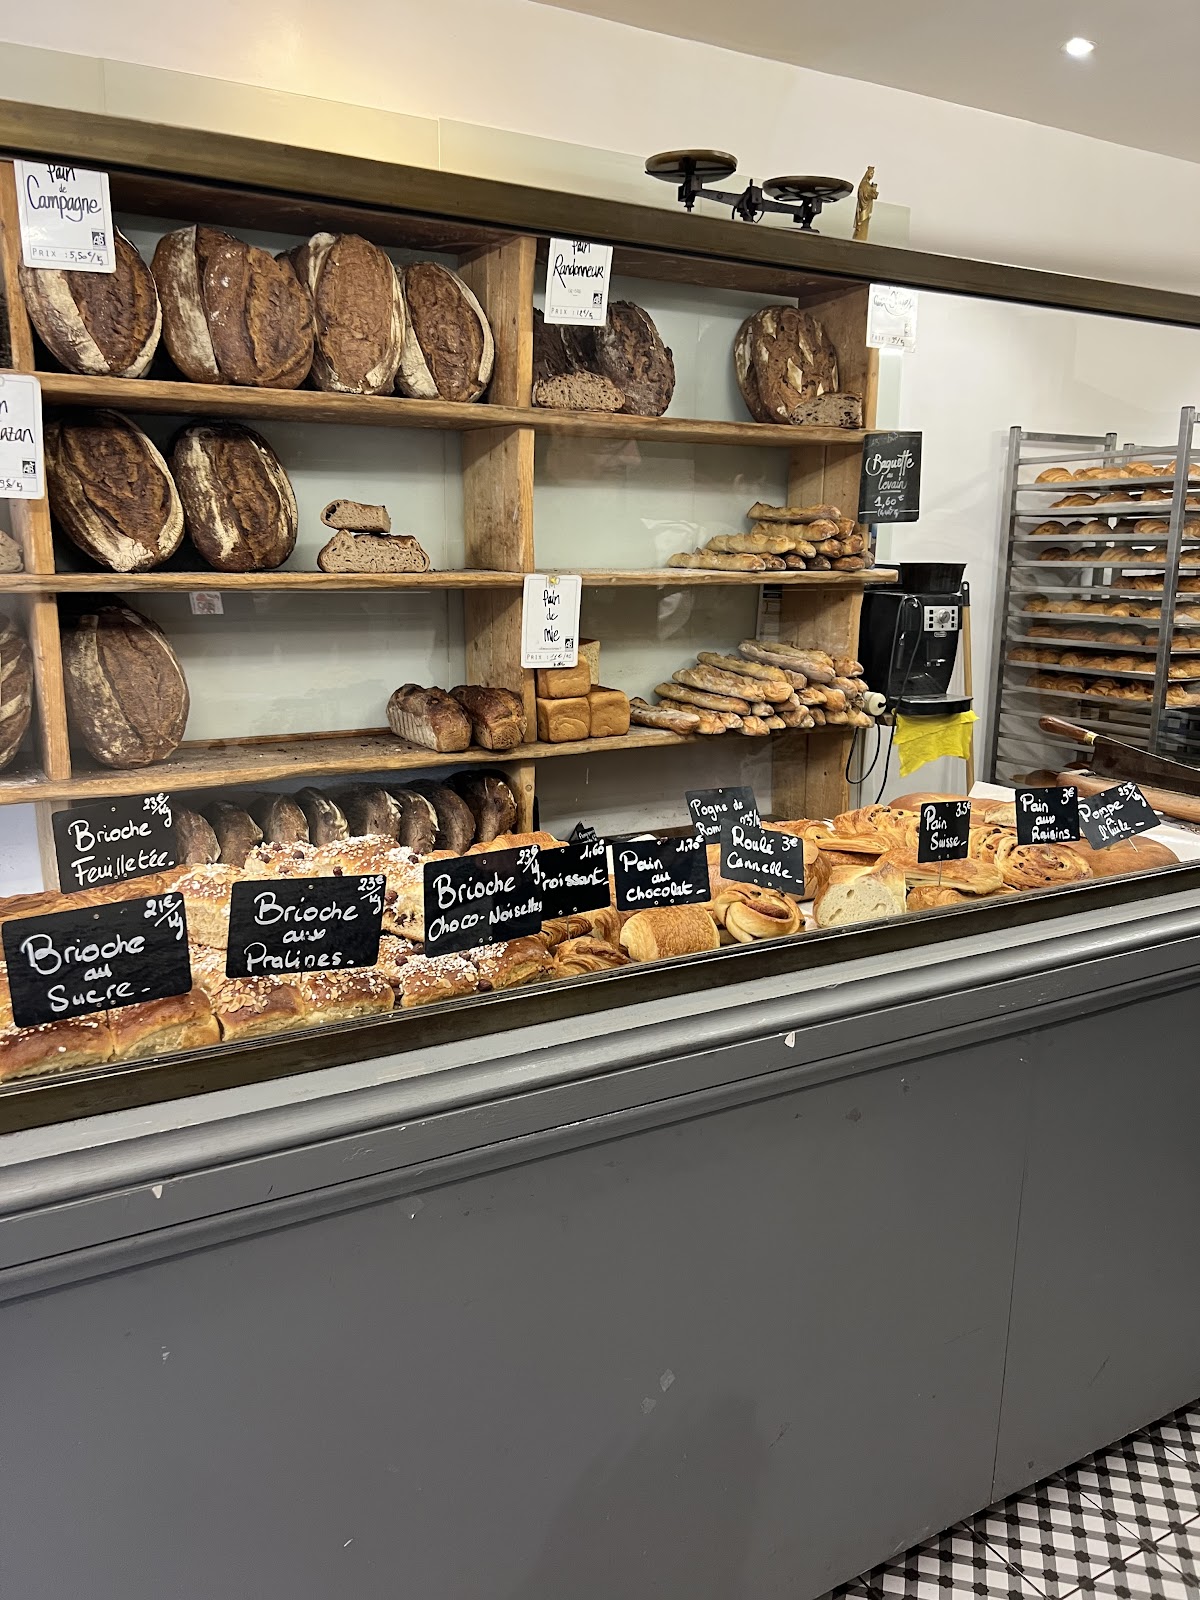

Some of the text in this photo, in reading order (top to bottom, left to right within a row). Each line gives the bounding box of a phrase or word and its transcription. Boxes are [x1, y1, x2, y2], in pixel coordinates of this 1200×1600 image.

[27, 174, 101, 222] Campagne
[59, 183, 67, 193] de
[32, 247, 57, 258] PRIX
[865, 449, 915, 476] Baguette
[543, 589, 560, 607] Pain
[546, 608, 558, 620] de
[1020, 793, 1049, 813] Pain
[1060, 787, 1074, 805] 3€
[690, 798, 744, 821] Pogne de
[924, 805, 947, 831] Pain
[1078, 800, 1124, 822] Pompe
[68, 819, 152, 852] Brioche
[695, 822, 722, 836] Rom
[731, 826, 775, 855] Roulé
[781, 836, 798, 851] 3€
[619, 850, 663, 872] Pain
[727, 851, 793, 879] Cannelle
[541, 867, 606, 891] roissant
[651, 871, 671, 884] au
[432, 871, 516, 909] Brioche
[254, 891, 359, 926] Brioche
[282, 928, 326, 944] aux
[21, 933, 146, 975] Brioche
[84, 964, 113, 981] au
[48, 982, 135, 1012] Sucre
